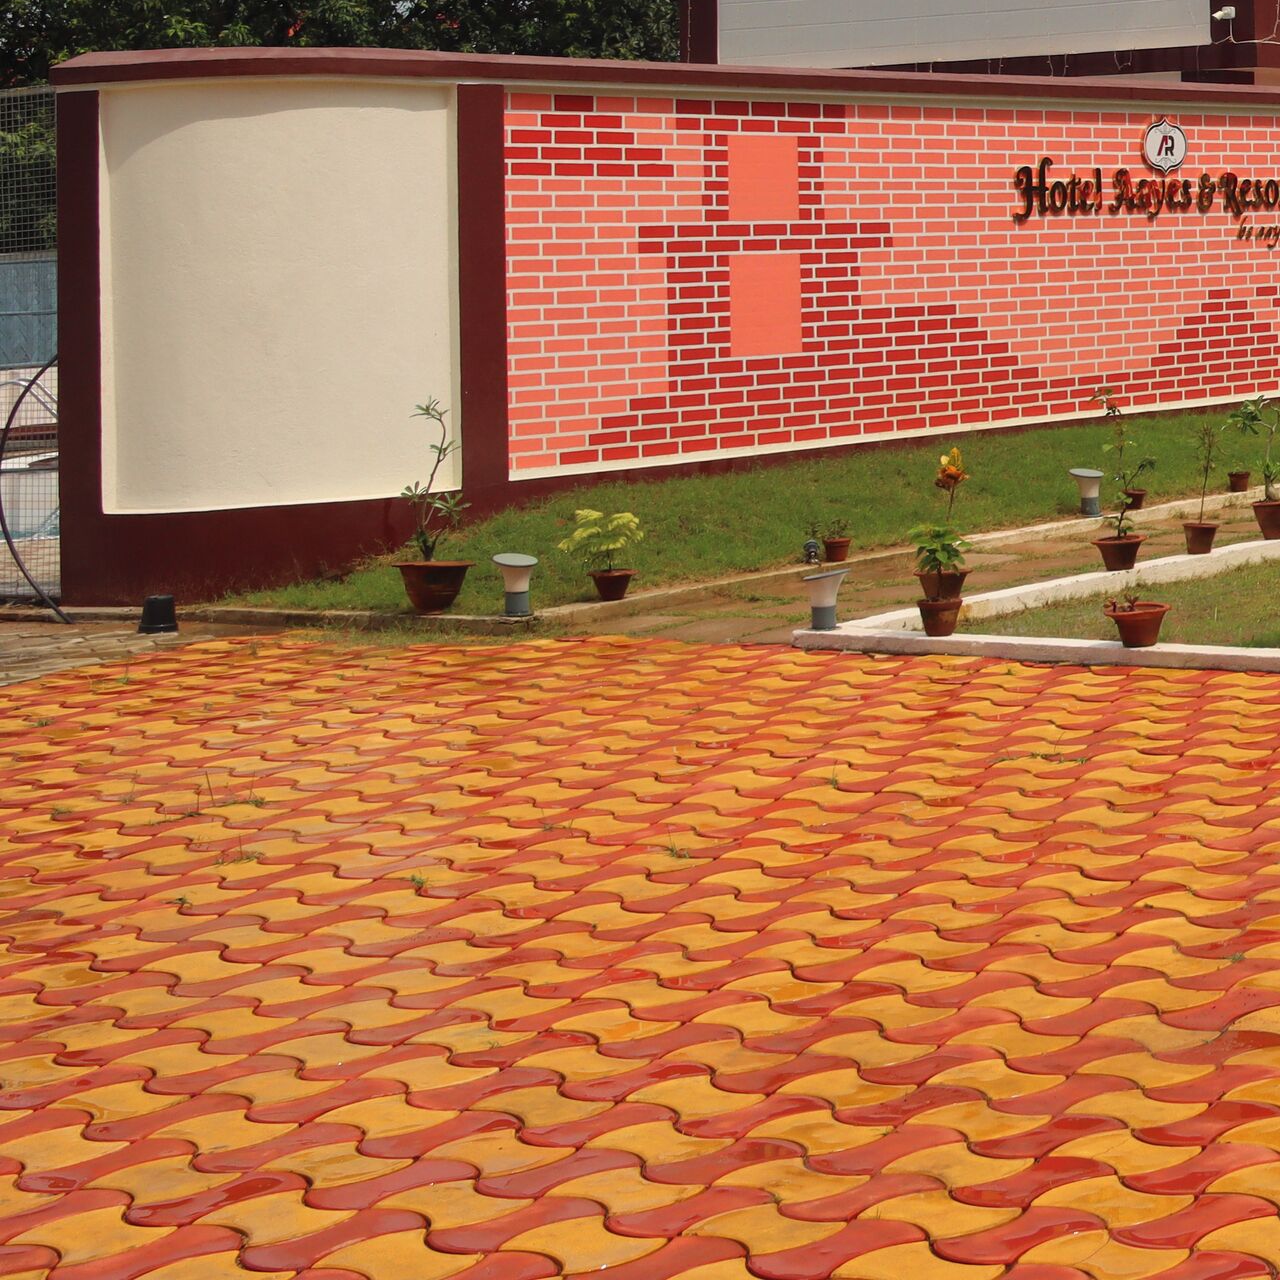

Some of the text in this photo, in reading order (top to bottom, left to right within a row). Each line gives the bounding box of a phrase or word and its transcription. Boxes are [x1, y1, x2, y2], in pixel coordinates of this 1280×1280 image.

[1012, 156, 1104, 224] Hotel
[1107, 167, 1192, 221] Aayes
[1197, 173, 1217, 213] &
